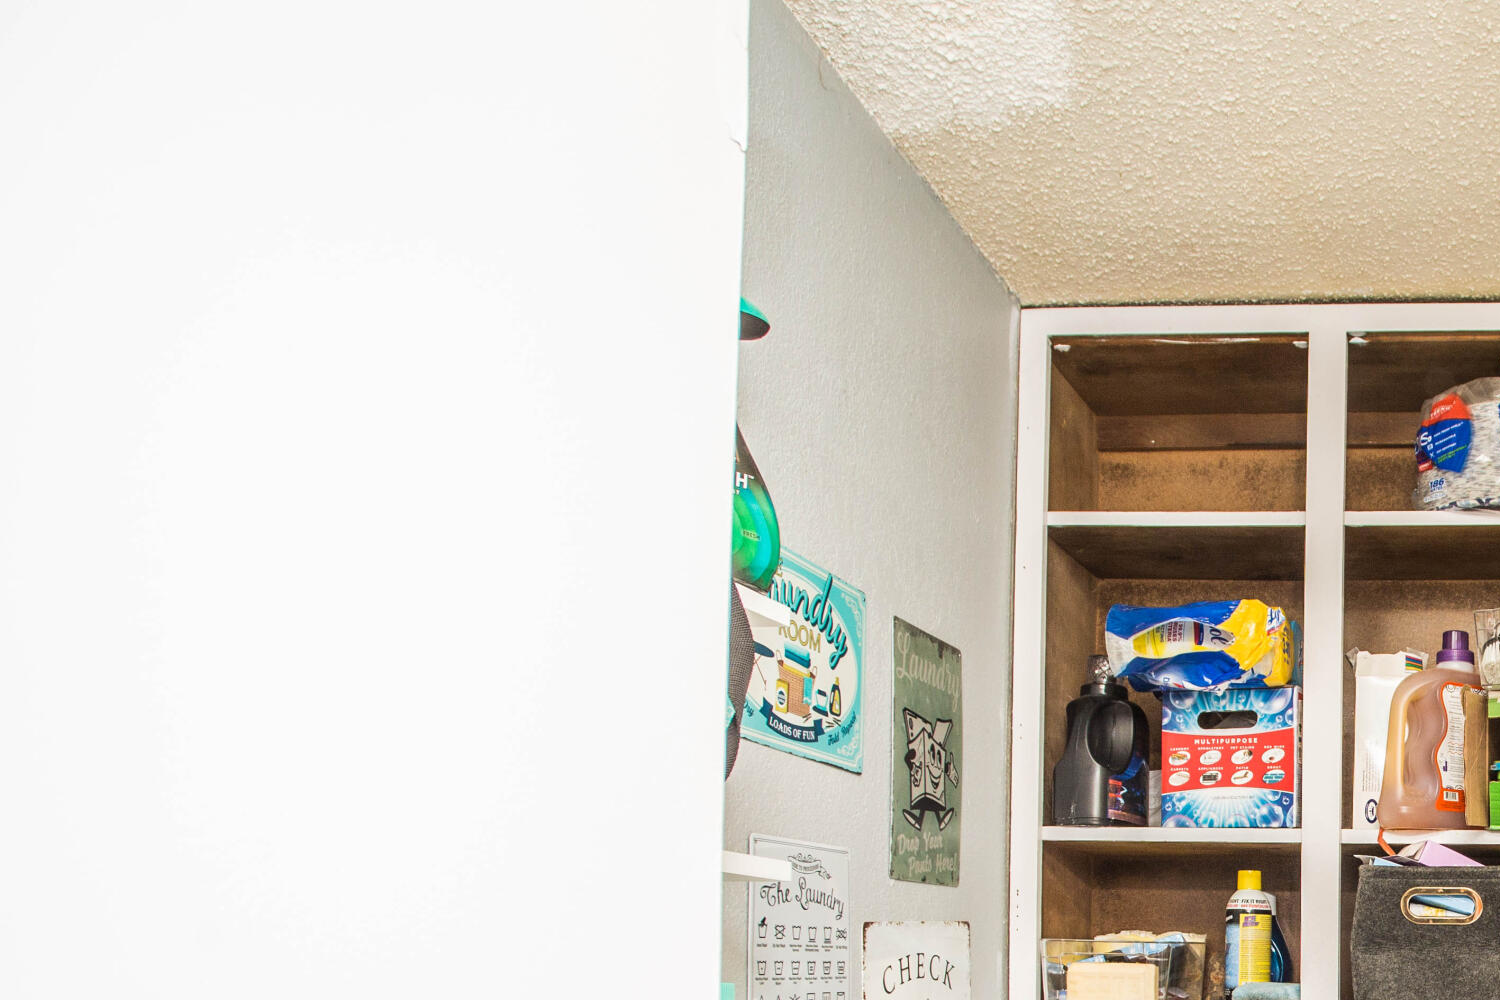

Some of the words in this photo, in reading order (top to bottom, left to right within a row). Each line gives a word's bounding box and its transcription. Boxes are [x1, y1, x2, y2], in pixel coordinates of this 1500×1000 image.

[1429, 478, 1445, 489] 186
[896, 631, 960, 713] Laundry
[769, 716, 792, 736] LOADS
[793, 728, 802, 739] OF
[803, 730, 815, 740] FUN
[1194, 737, 1258, 745] MULTIPURPOSE
[760, 881, 791, 907] The
[795, 876, 845, 920] Laundry
[882, 952, 955, 995] CHECK
